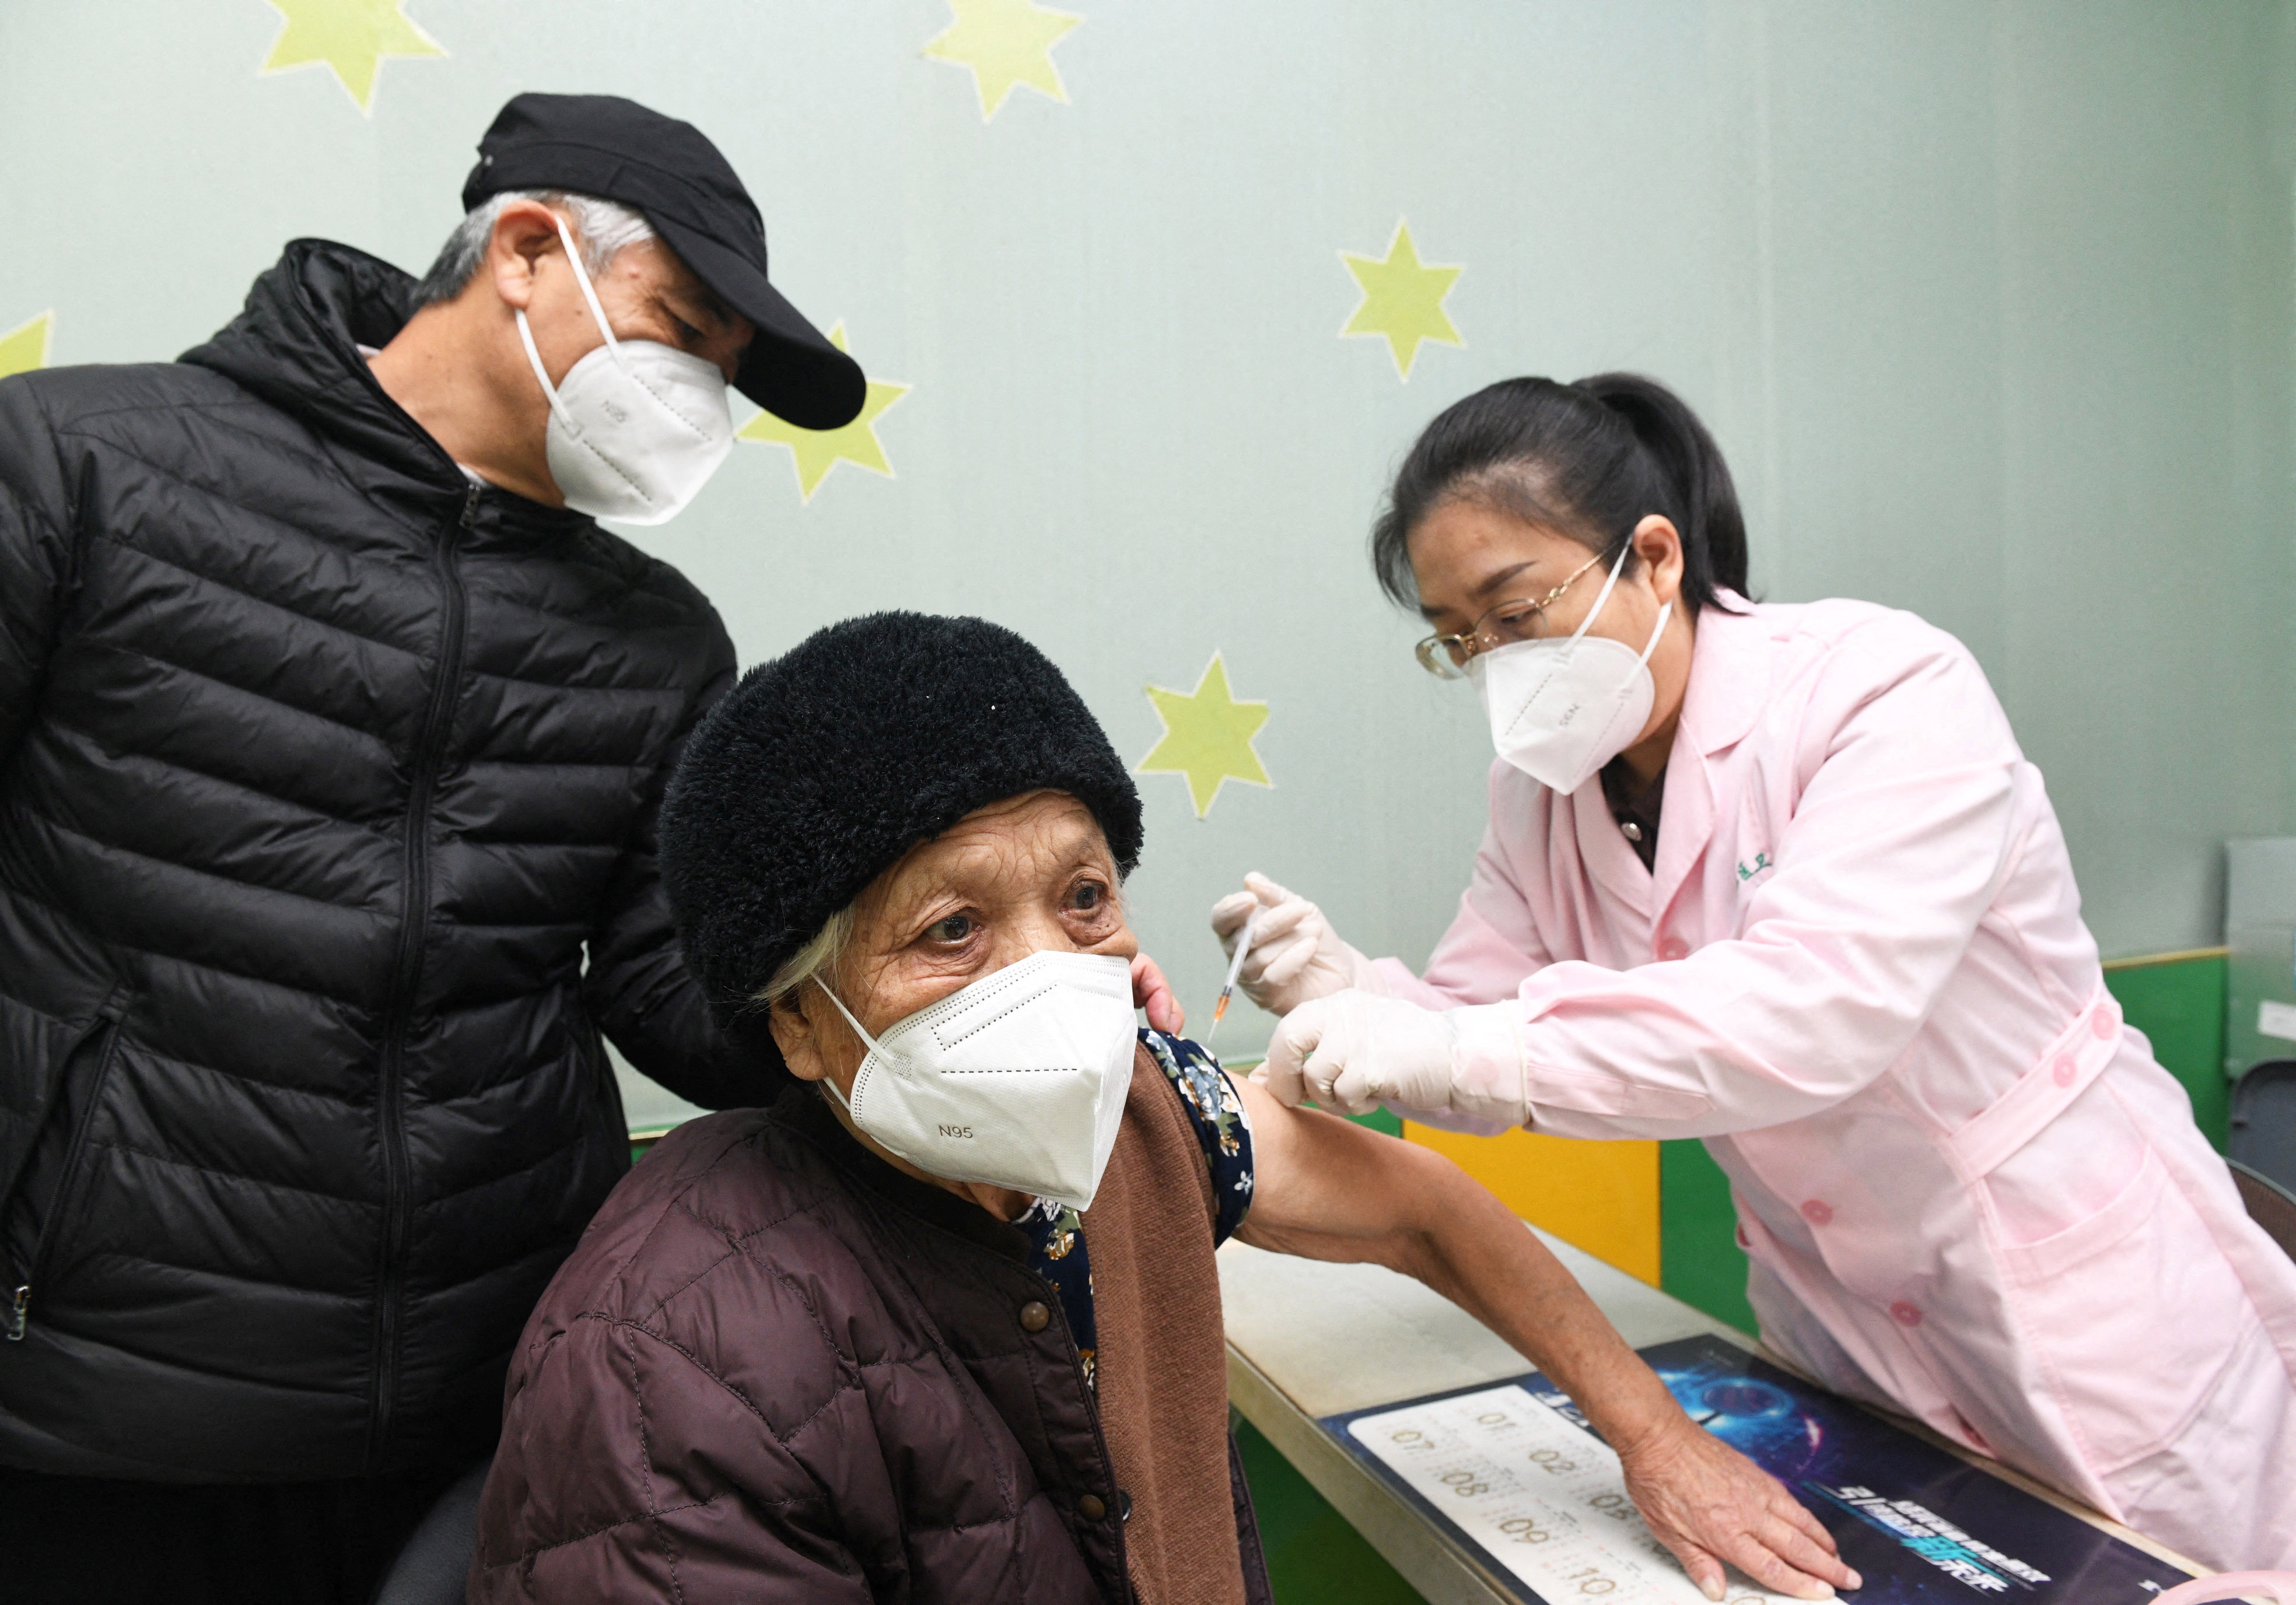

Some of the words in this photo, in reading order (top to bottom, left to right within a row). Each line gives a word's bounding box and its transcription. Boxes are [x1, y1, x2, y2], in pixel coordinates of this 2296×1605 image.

[939, 1125, 973, 1138] N95
[1478, 1413, 1516, 1431] 01
[1391, 1430, 1435, 1450] 07
[1529, 1450, 1576, 1474] 02
[1441, 1471, 1489, 1497] 08
[1499, 1519, 1549, 1544] 09
[1567, 1568, 1616, 1595] 10
